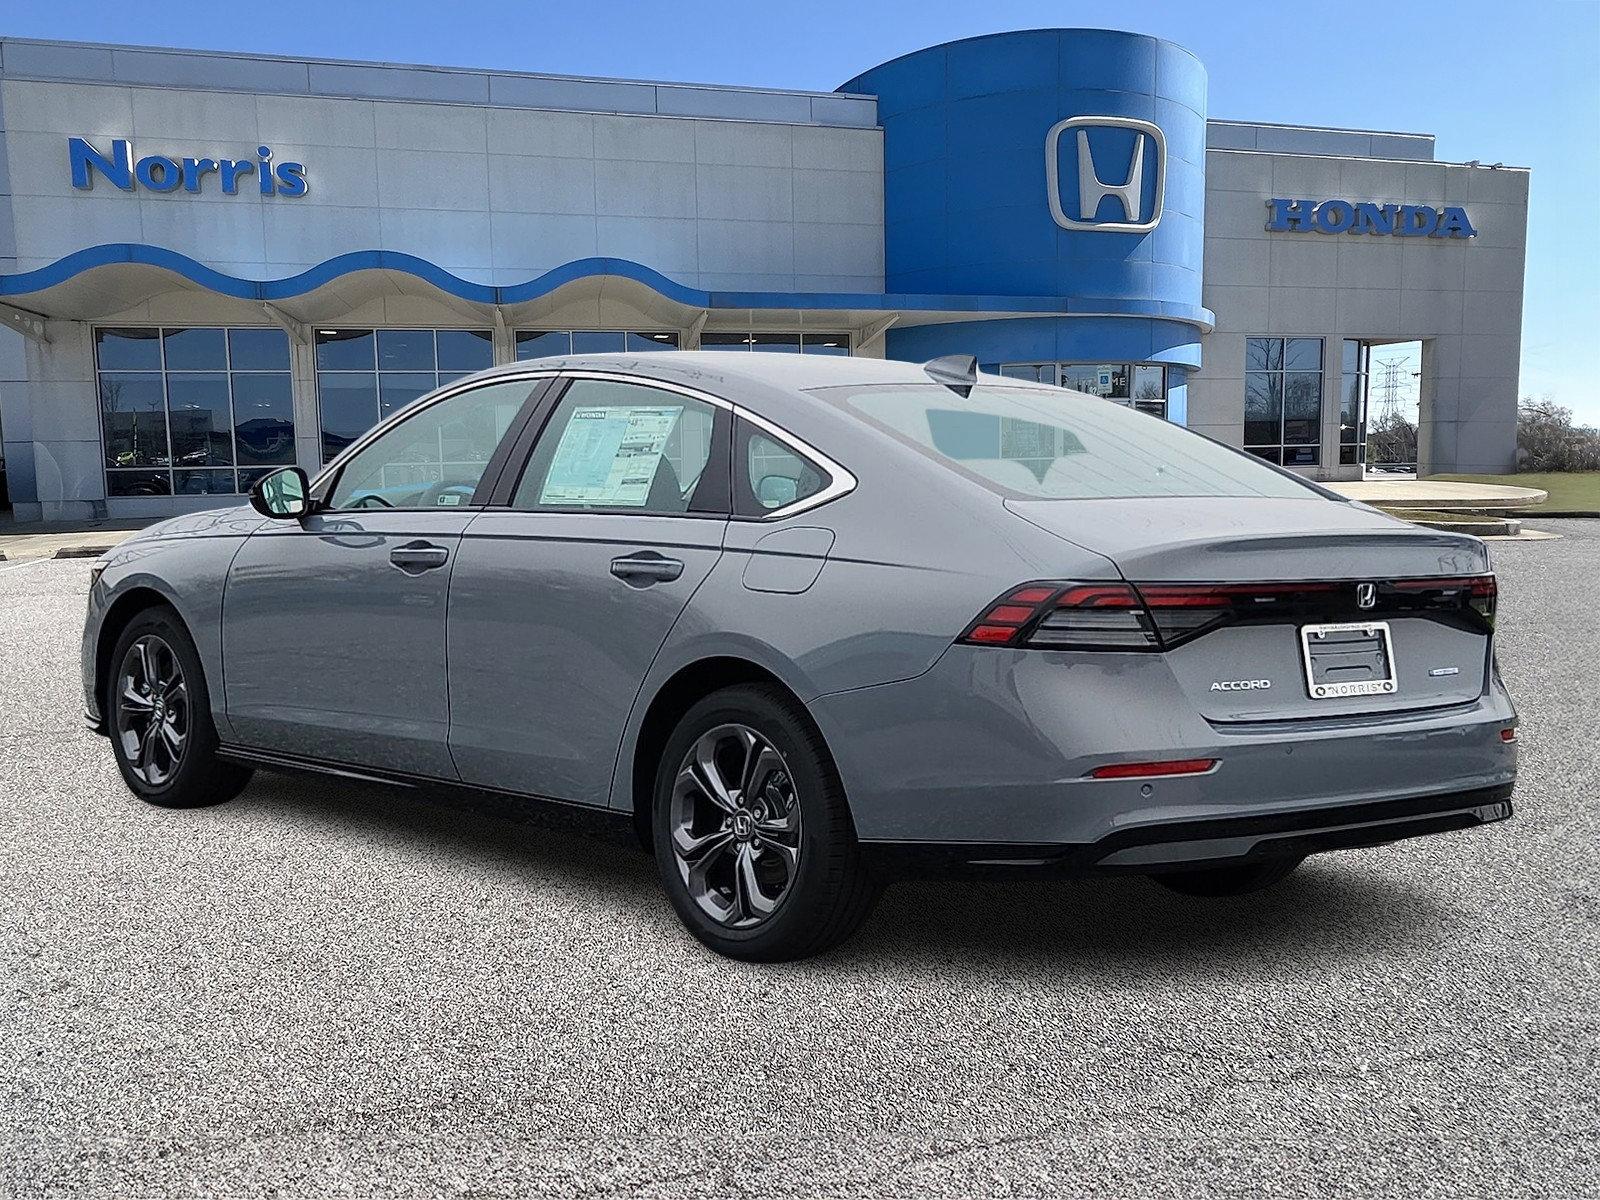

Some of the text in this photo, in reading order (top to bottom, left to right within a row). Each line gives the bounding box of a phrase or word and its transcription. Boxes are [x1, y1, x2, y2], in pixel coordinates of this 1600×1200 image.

[67, 137, 308, 197] Norris
[1266, 198, 1477, 238] HONDA
[1210, 679, 1271, 691] ACCORD
